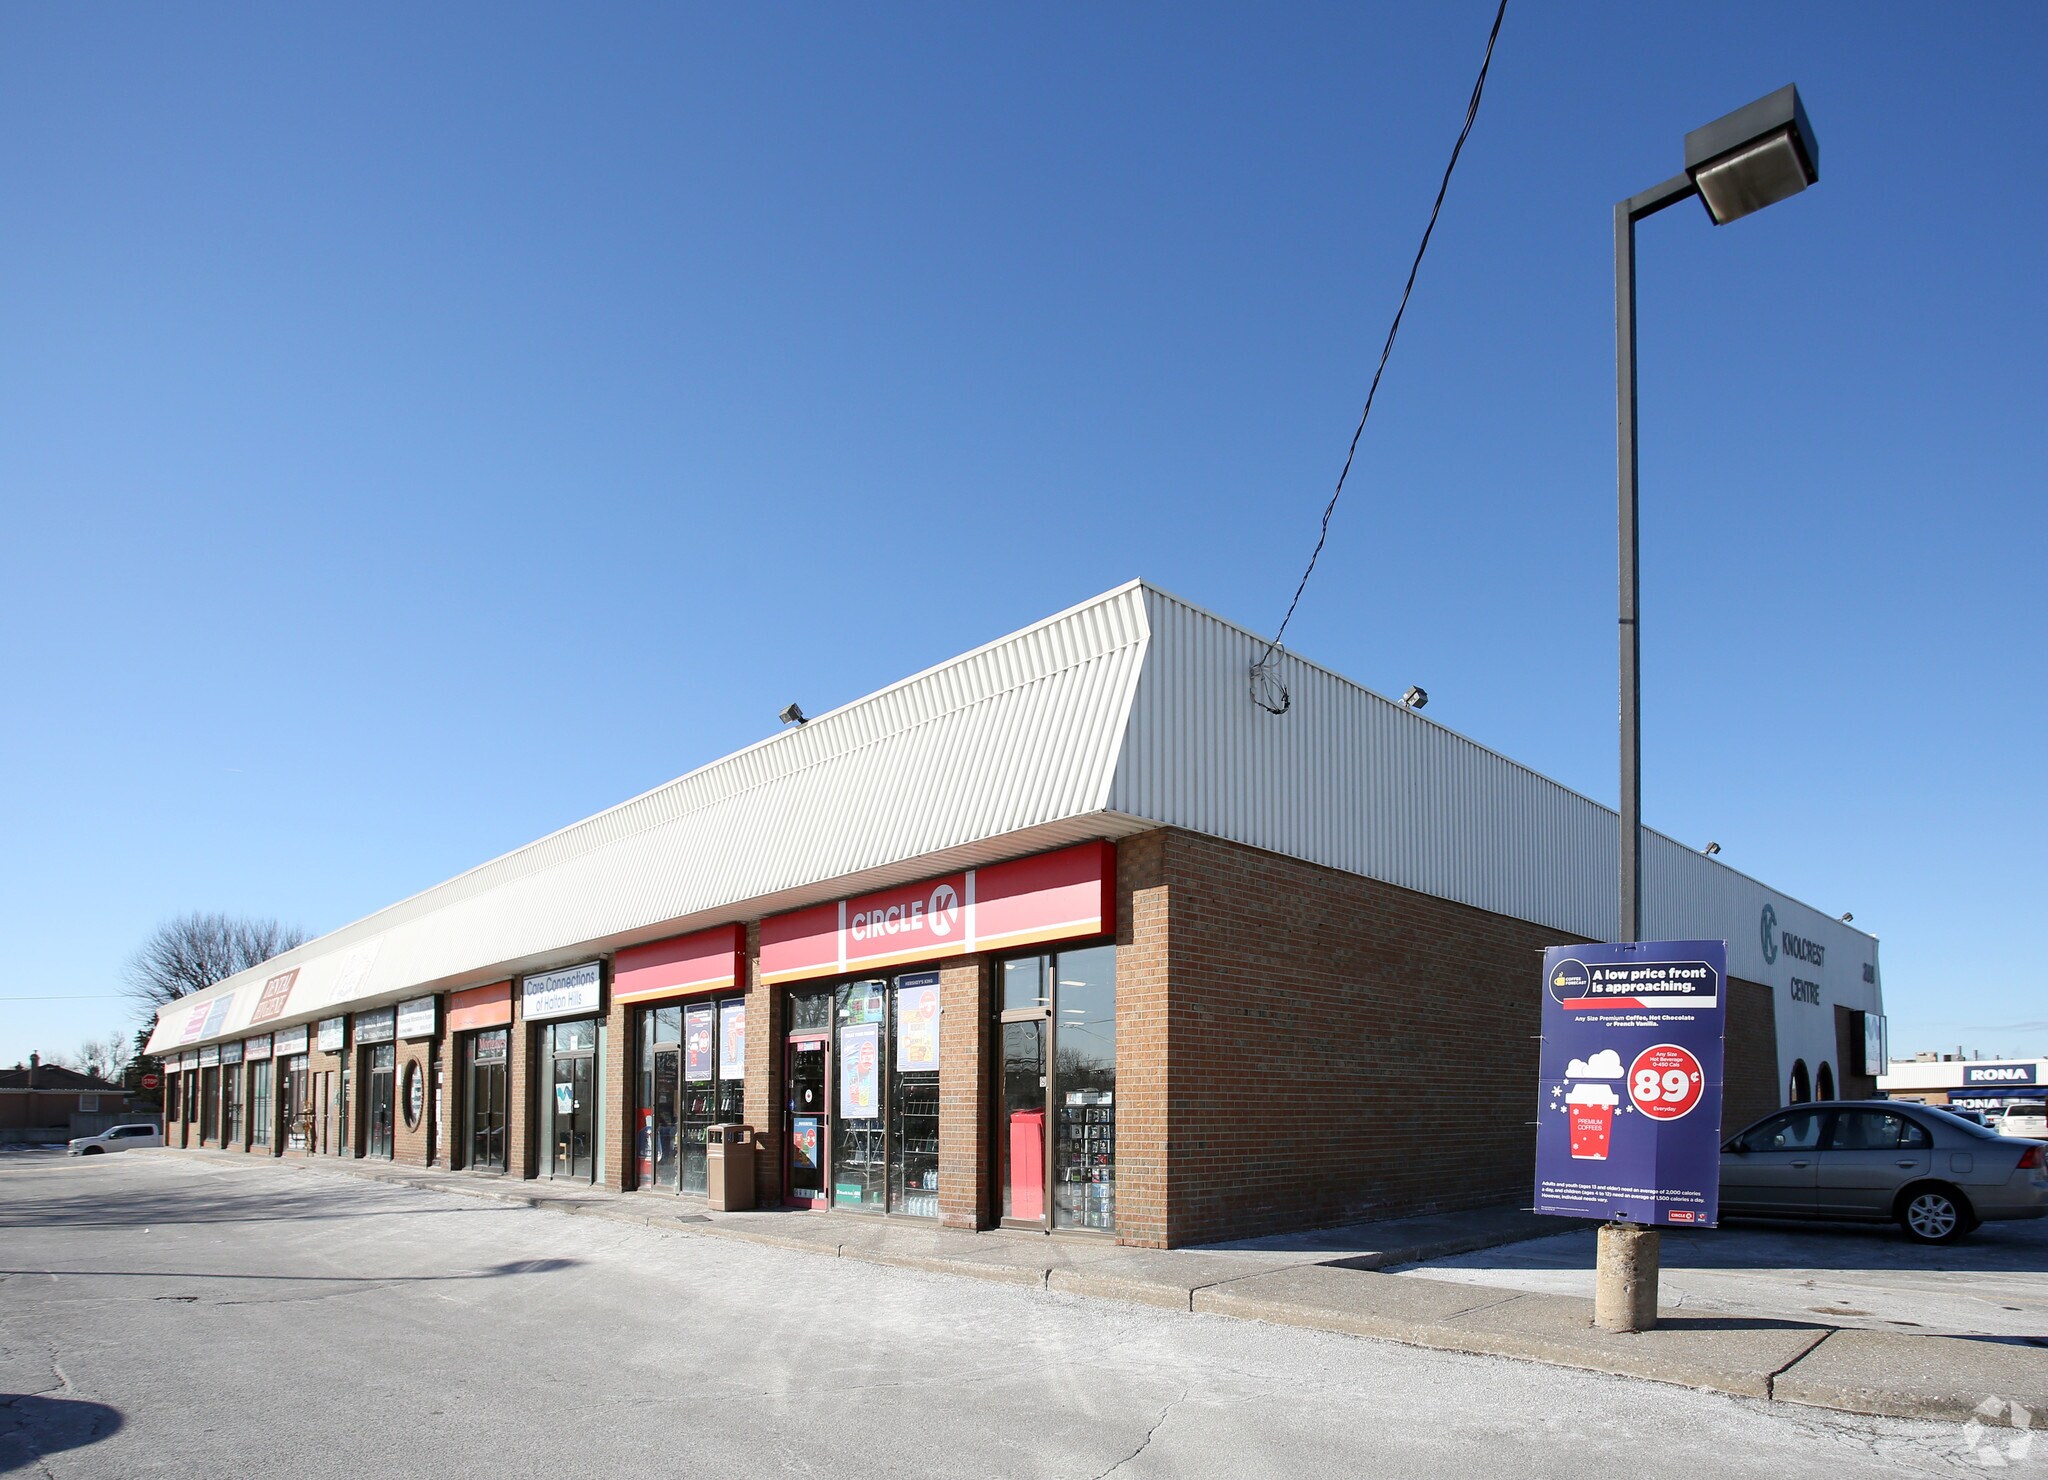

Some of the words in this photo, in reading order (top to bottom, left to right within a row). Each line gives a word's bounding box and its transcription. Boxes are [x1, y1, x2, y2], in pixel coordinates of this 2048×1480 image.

[851, 900, 923, 941] CIRCLE
[930, 887, 958, 935] K
[1782, 930, 1825, 967] KNOLCREST
[526, 980, 545, 996] Care
[545, 971, 595, 992] Connections
[1592, 970, 1603, 980] A
[1605, 969, 1629, 980] low
[1630, 968, 1666, 981] price
[1668, 967, 1707, 979] front
[1592, 982, 1604, 993] is
[1605, 980, 1696, 994] approaching.
[1791, 976, 1820, 1006] CENTRE
[535, 1000, 543, 1012] of
[544, 994, 566, 1011] Halton
[568, 990, 582, 1006] Hills
[1970, 1068, 2028, 1081] RONA
[1952, 1098, 2001, 1109] RONA
